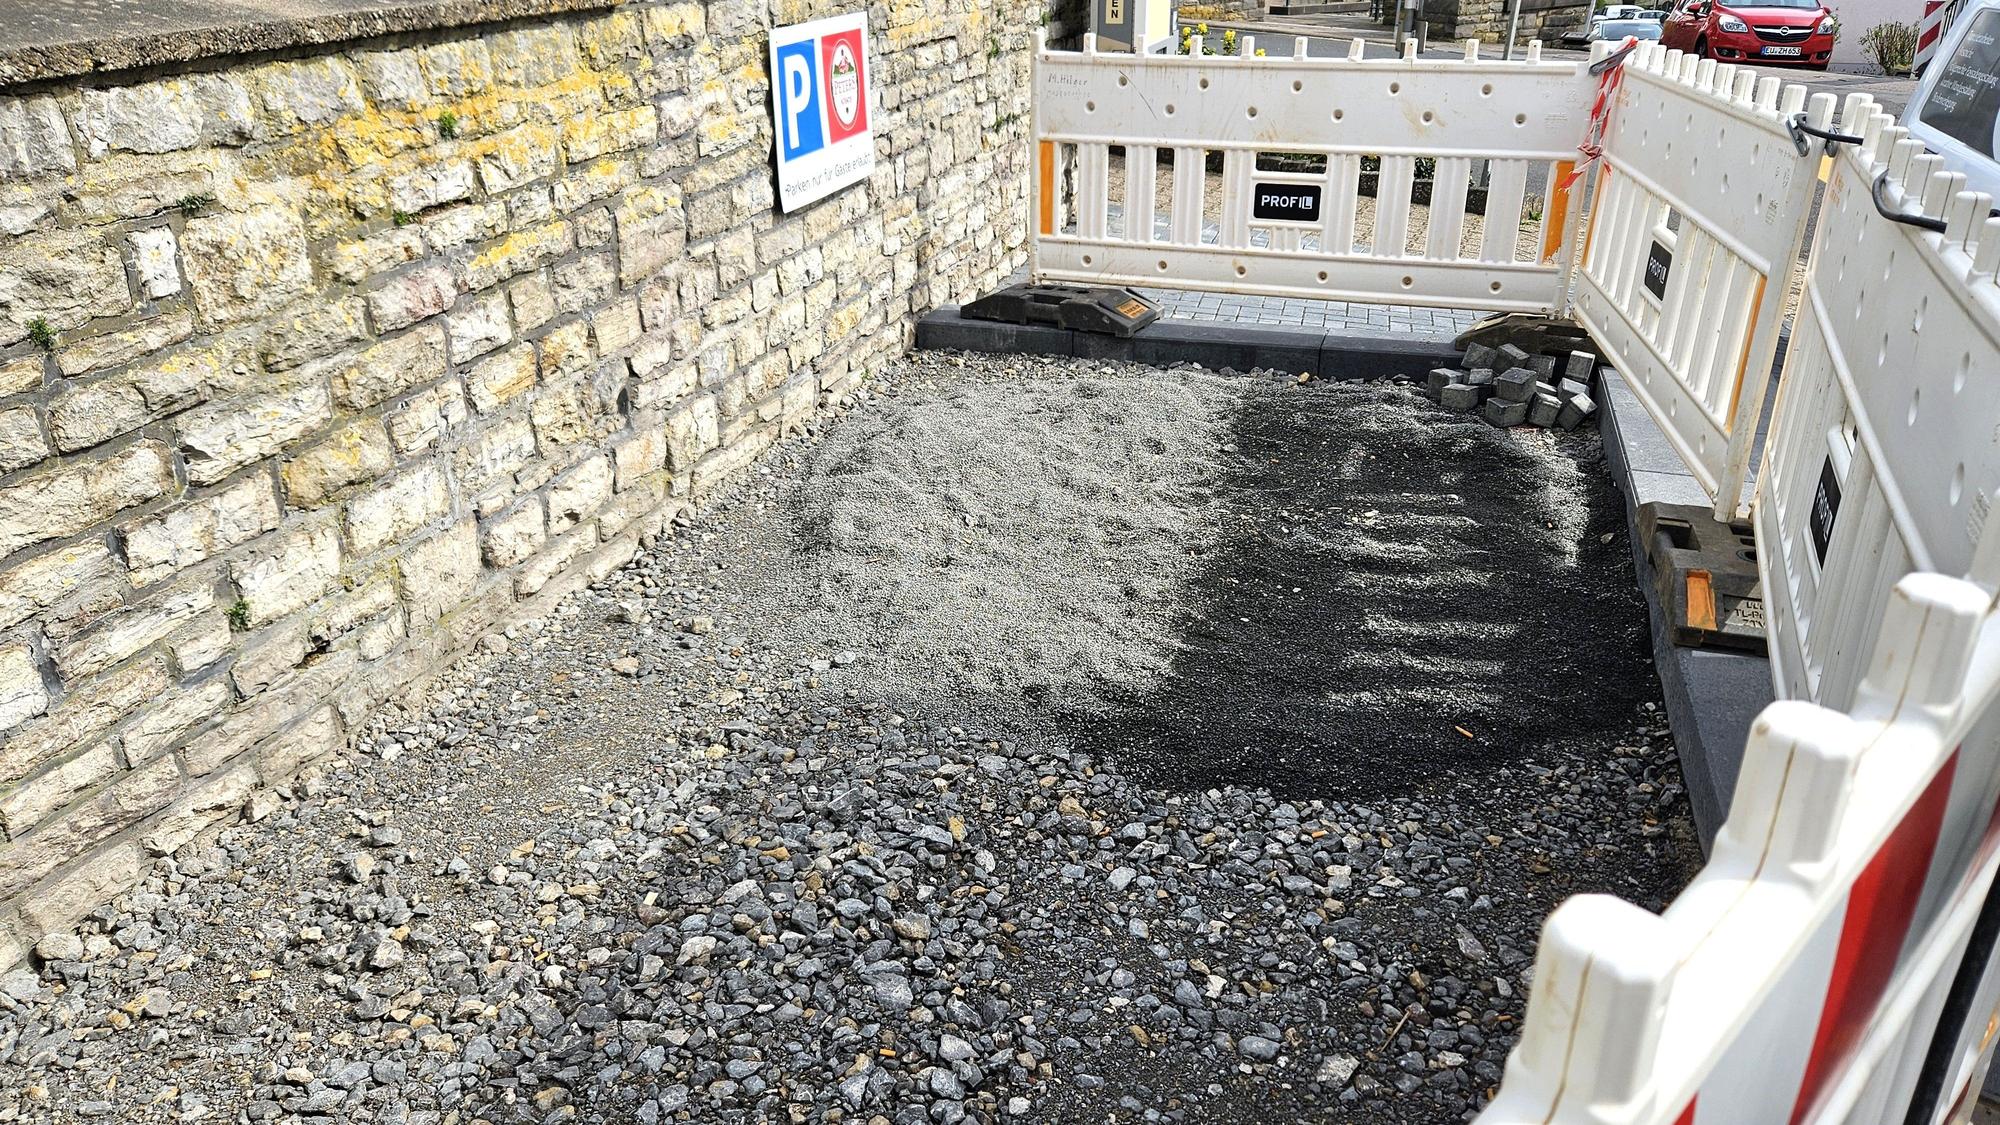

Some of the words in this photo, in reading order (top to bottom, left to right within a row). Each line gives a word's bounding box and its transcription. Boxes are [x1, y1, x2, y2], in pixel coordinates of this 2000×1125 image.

[784, 54, 811, 150] P
[785, 179, 811, 197] Parken
[812, 174, 822, 188] nur
[1260, 195, 1314, 210] PROFIL
[1648, 256, 1667, 285] PROFIL
